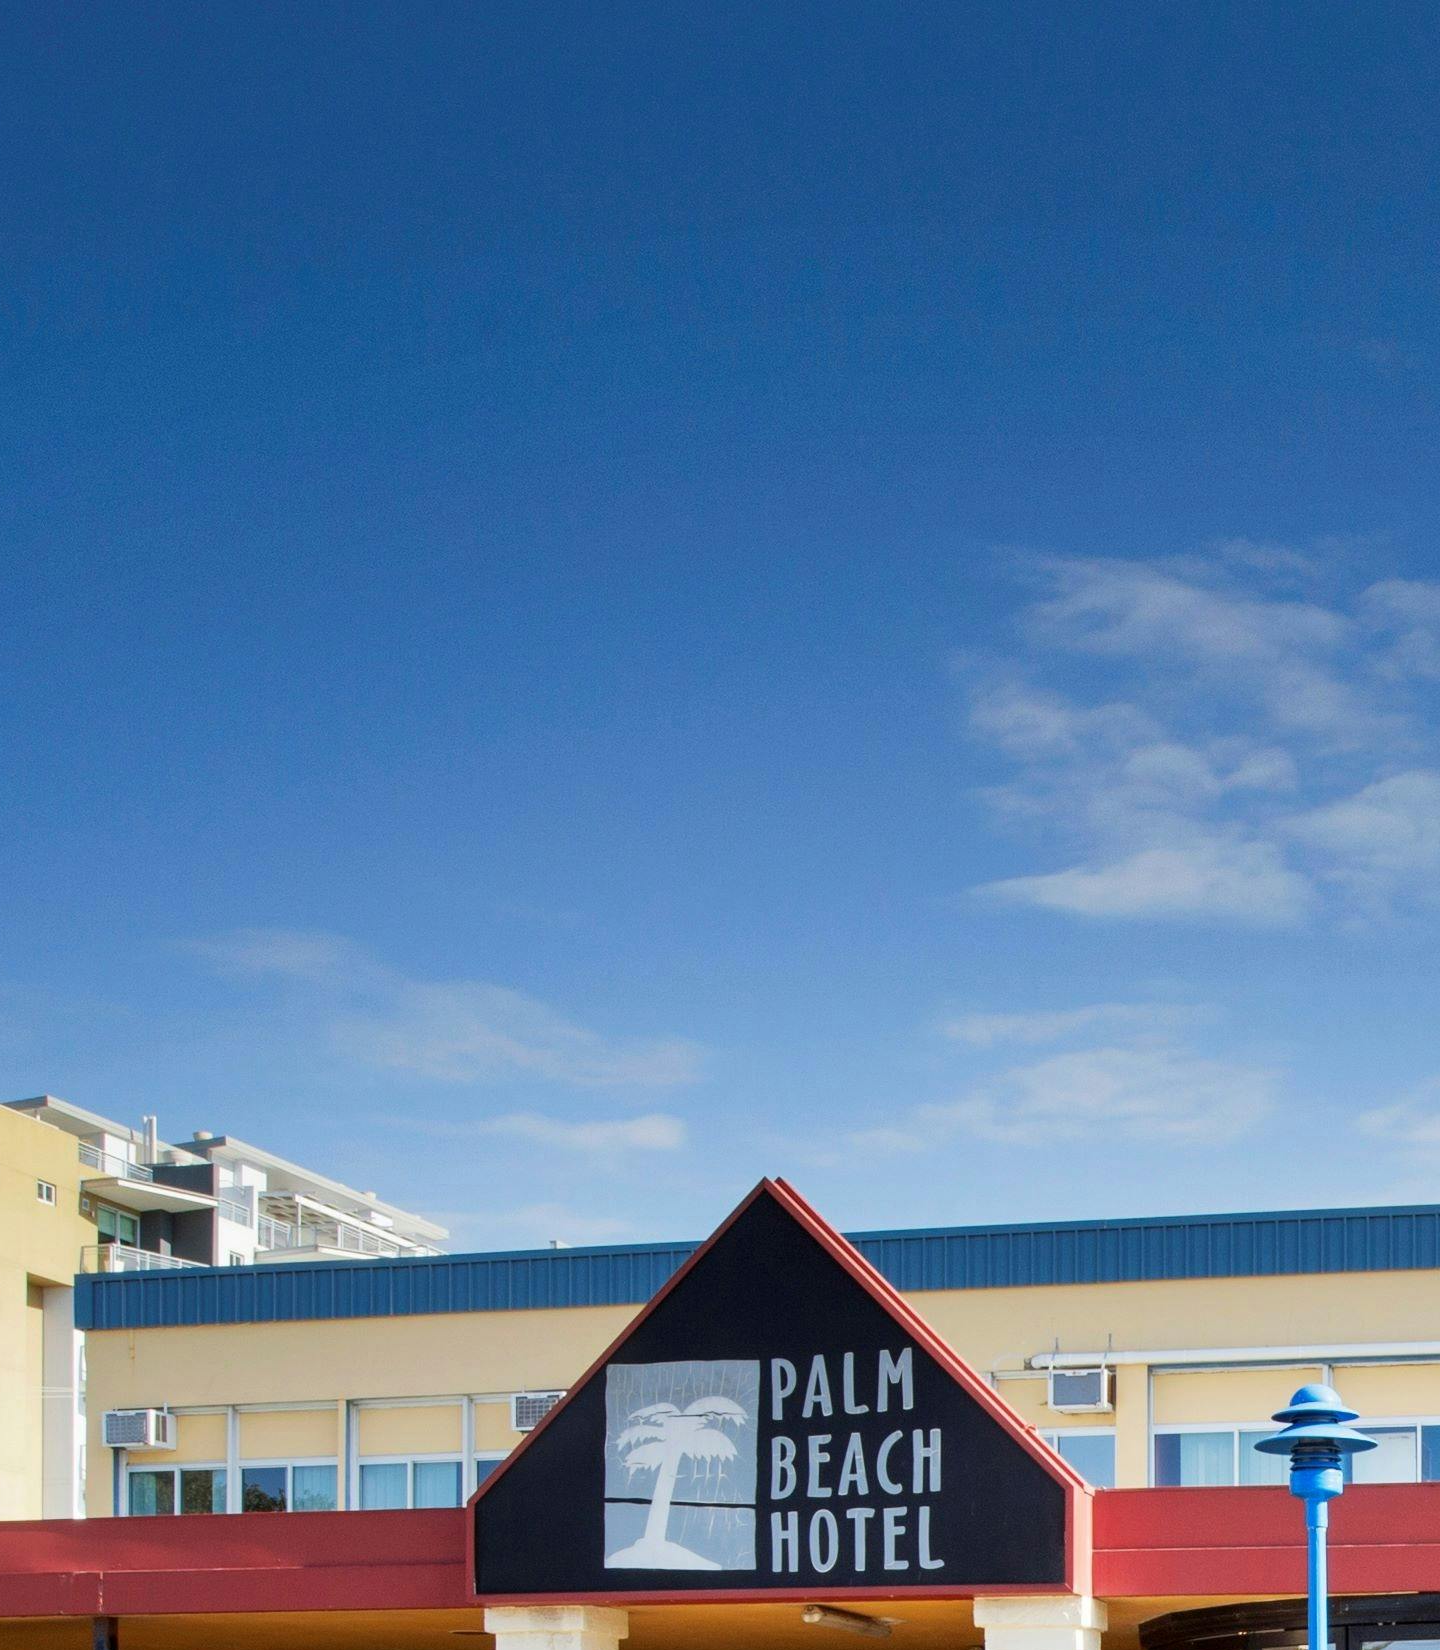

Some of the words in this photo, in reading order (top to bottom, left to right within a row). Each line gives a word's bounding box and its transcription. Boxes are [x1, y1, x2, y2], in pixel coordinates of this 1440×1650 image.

[771, 1347, 914, 1421] PALM
[770, 1428, 941, 1500] BEACH
[770, 1506, 945, 1573] HOTEL
